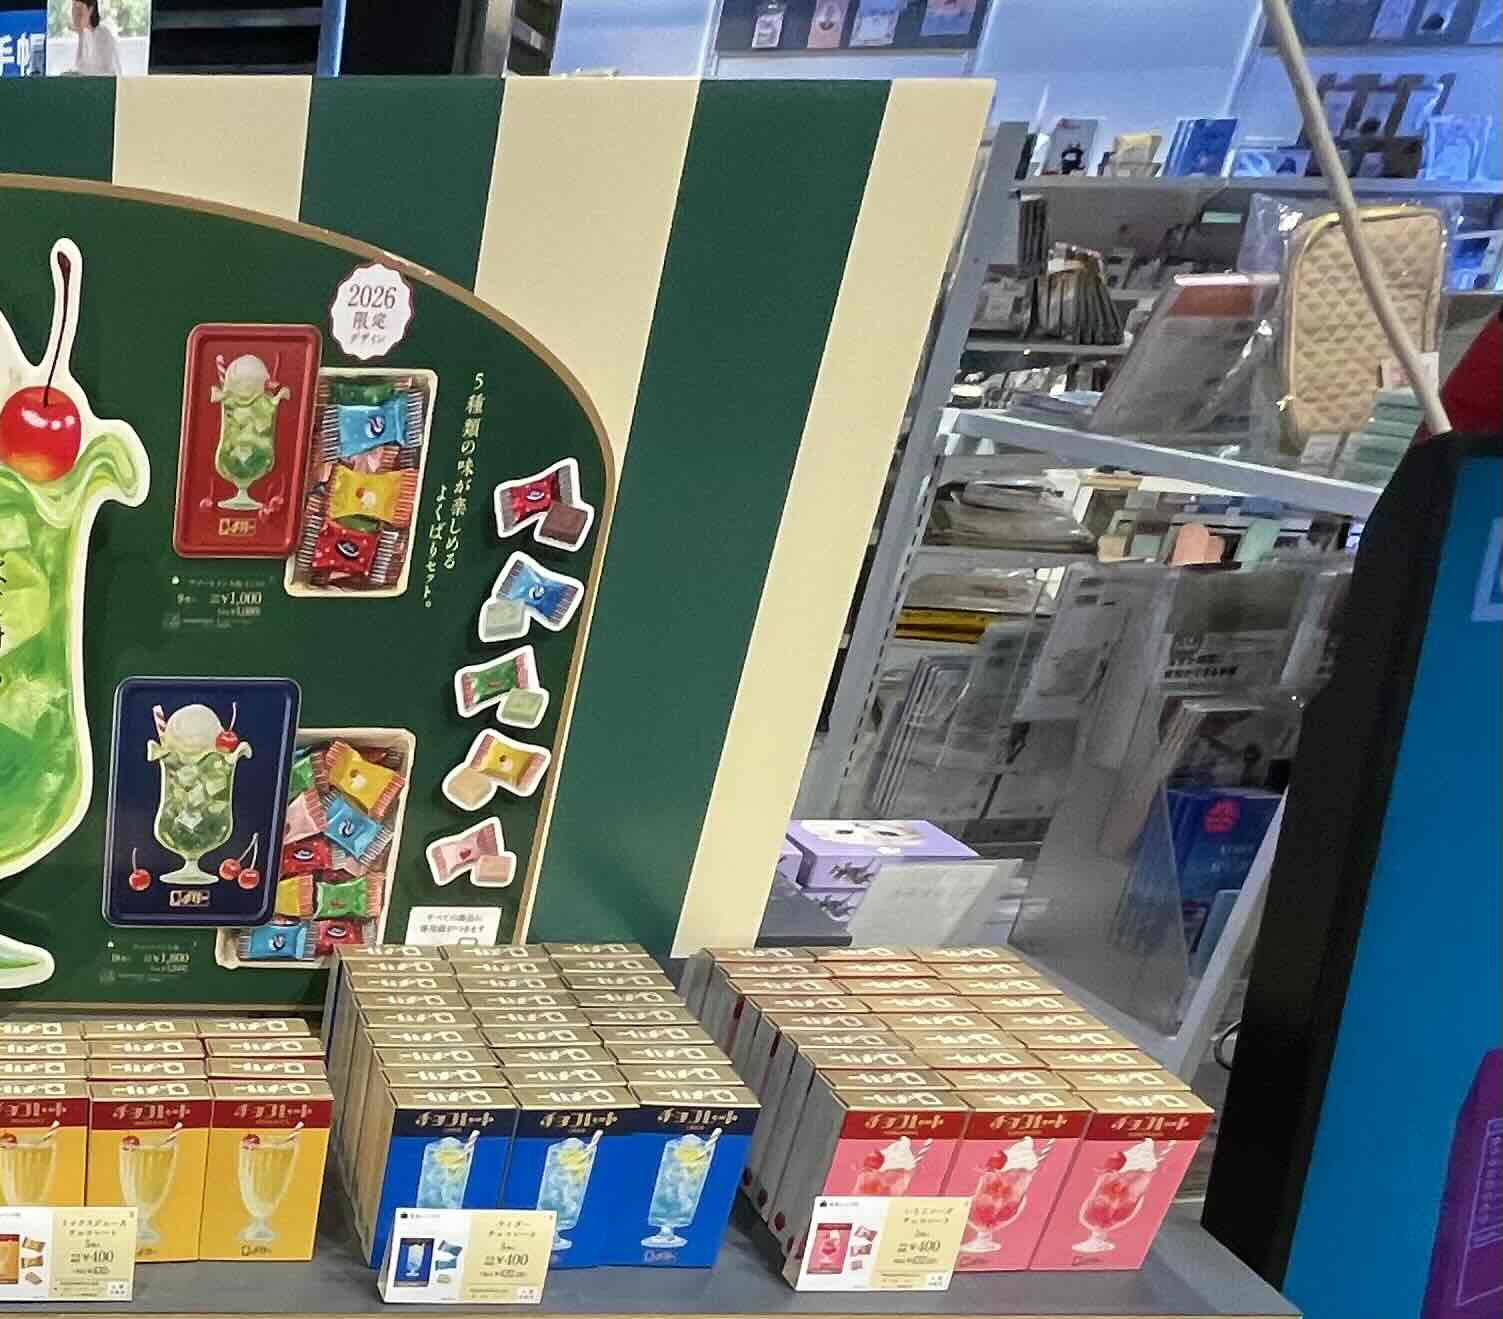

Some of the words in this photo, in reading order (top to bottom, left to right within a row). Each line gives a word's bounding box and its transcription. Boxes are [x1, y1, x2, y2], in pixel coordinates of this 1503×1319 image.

[347, 284, 397, 309] 2026
[352, 312, 387, 330] 限定
[442, 372, 487, 569] 5種類の味が楽しめる
